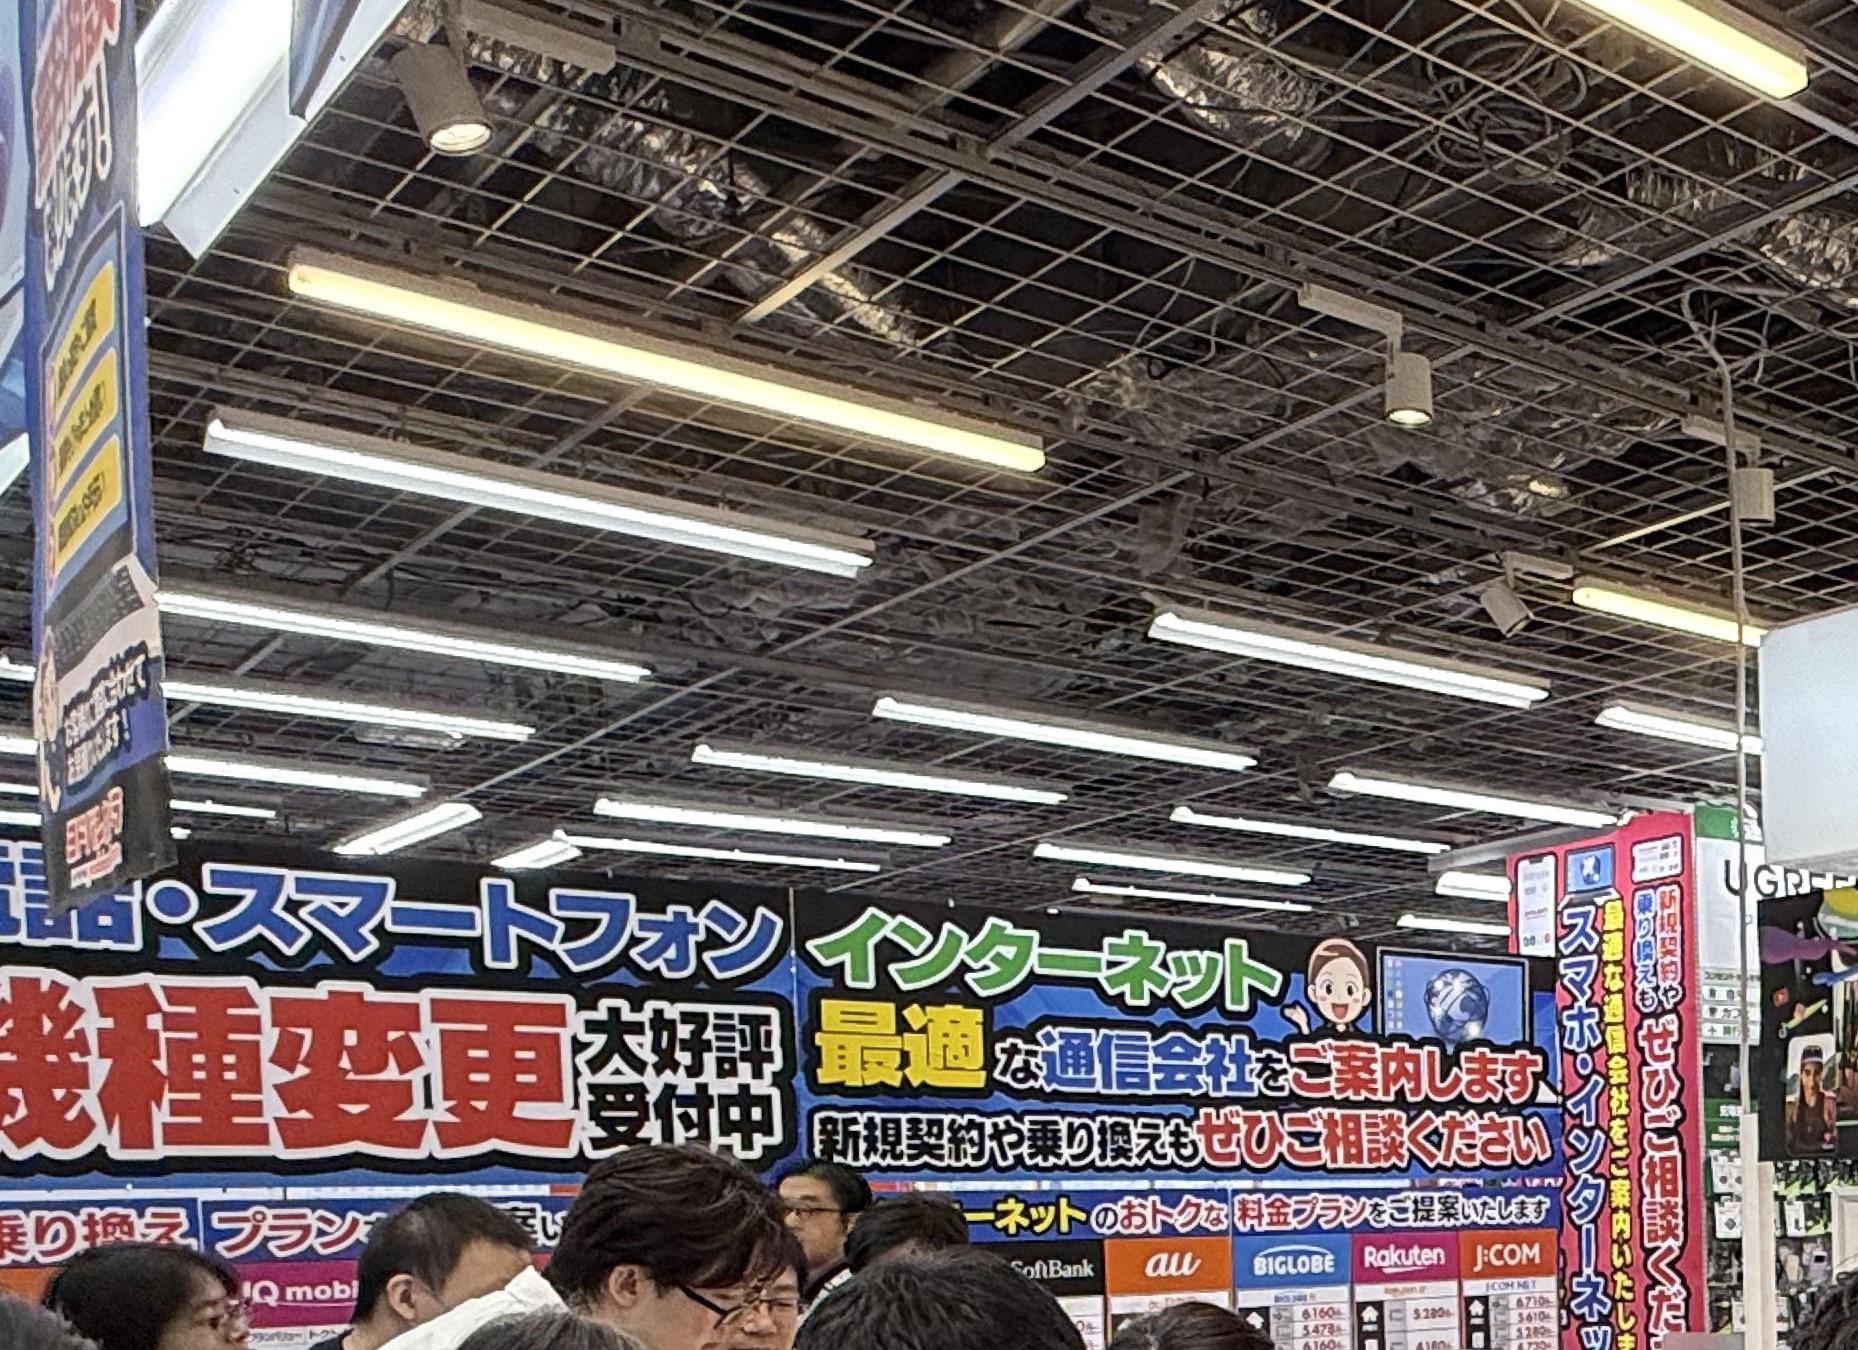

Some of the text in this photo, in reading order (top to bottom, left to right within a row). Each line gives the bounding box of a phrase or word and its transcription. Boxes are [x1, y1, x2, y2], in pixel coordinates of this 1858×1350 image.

[0, 840, 783, 980] 話・スマートフォン
[810, 906, 1285, 1013] インターネット
[1633, 887, 1657, 1012] 乗り換えも
[1656, 884, 1683, 1010] 新規契約や
[0, 973, 780, 1159] 機種変更 大好評
[815, 997, 1543, 1105] 最適な通信会社をご案内します
[580, 1078, 783, 1160] 受付中
[812, 1106, 1552, 1170] 新規契約や乗り換えもぜひご相談ください
[955, 1189, 1549, 1237] ーネットのおトクな 料金プランをご提案いたします
[1010, 1258, 1095, 1280] SoftBank
[1145, 1251, 1202, 1278] au
[1253, 1253, 1336, 1277] BIGLOBE
[1363, 1244, 1446, 1268] Rakuten
[1472, 1243, 1542, 1272] J:COM
